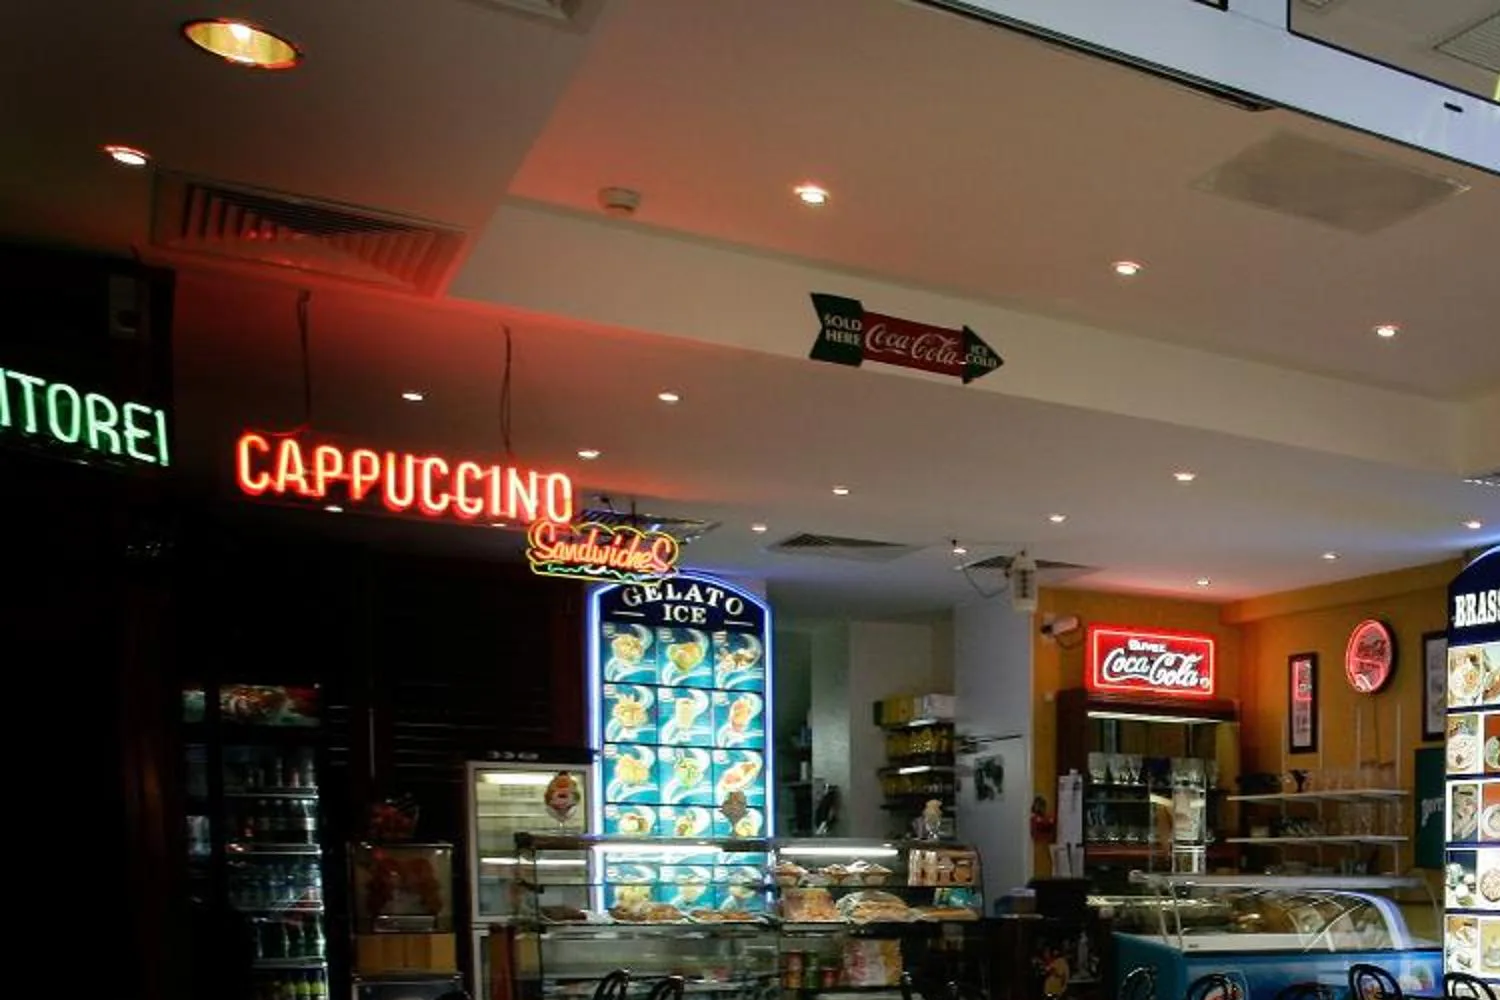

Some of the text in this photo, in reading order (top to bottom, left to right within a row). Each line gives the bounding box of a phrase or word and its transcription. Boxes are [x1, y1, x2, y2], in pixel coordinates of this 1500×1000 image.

[237, 432, 574, 526] CAPPUCCINO
[622, 583, 745, 616] GELATO
[662, 603, 707, 624] ICE
